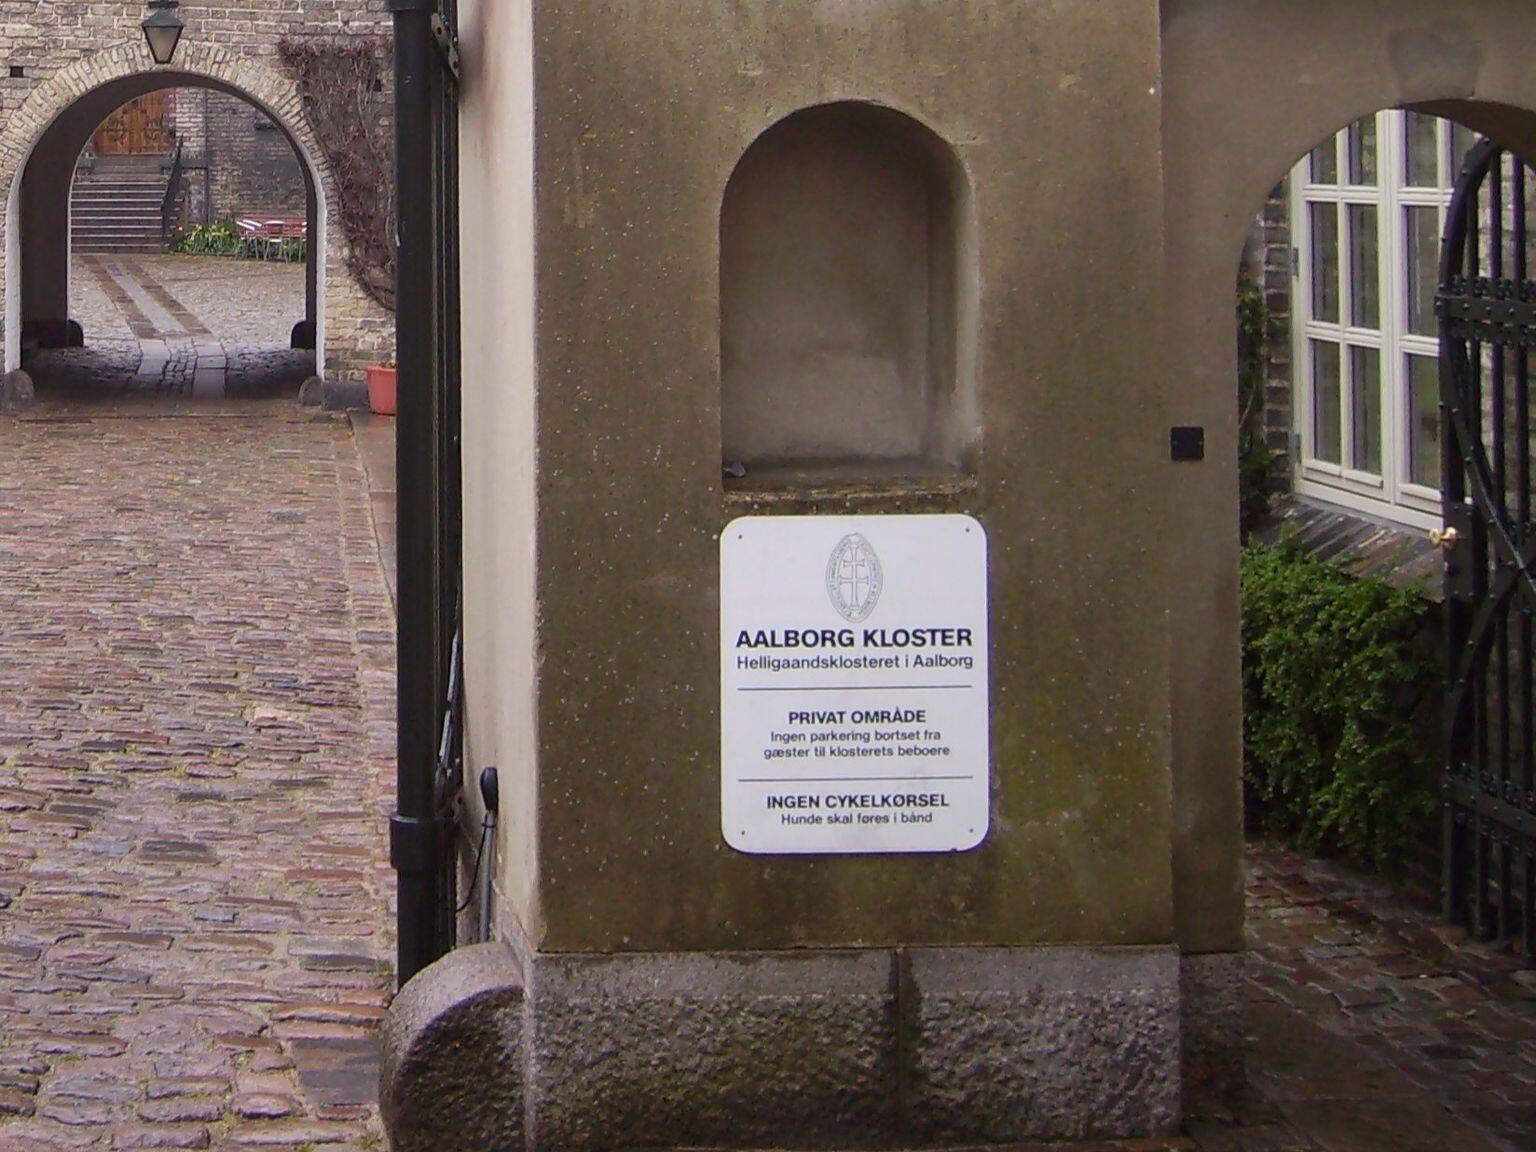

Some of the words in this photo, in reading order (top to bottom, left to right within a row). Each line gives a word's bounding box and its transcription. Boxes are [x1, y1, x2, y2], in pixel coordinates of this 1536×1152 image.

[736, 629, 854, 648] AALBORG
[863, 628, 973, 647] KLOSTER
[736, 655, 900, 672] Helligaandsklosteret
[904, 654, 909, 668] i
[912, 654, 974, 670] Aalborg
[788, 711, 847, 725] PRIVAT
[851, 706, 927, 724] OMRÅDE
[770, 731, 806, 744] Ingen
[810, 730, 871, 744] parkering
[874, 729, 920, 741] bortset
[923, 729, 942, 741] fra
[763, 748, 810, 760] gæster
[814, 746, 826, 758] til
[829, 745, 894, 757] klosterets
[897, 745, 951, 757] beboere
[766, 795, 820, 809] INGEN
[825, 793, 950, 809] CYKELKØRSEL
[780, 813, 822, 825] Hunde
[826, 812, 853, 825] skal
[857, 812, 890, 825] føres
[893, 812, 898, 824] i
[901, 811, 934, 824] bånd
